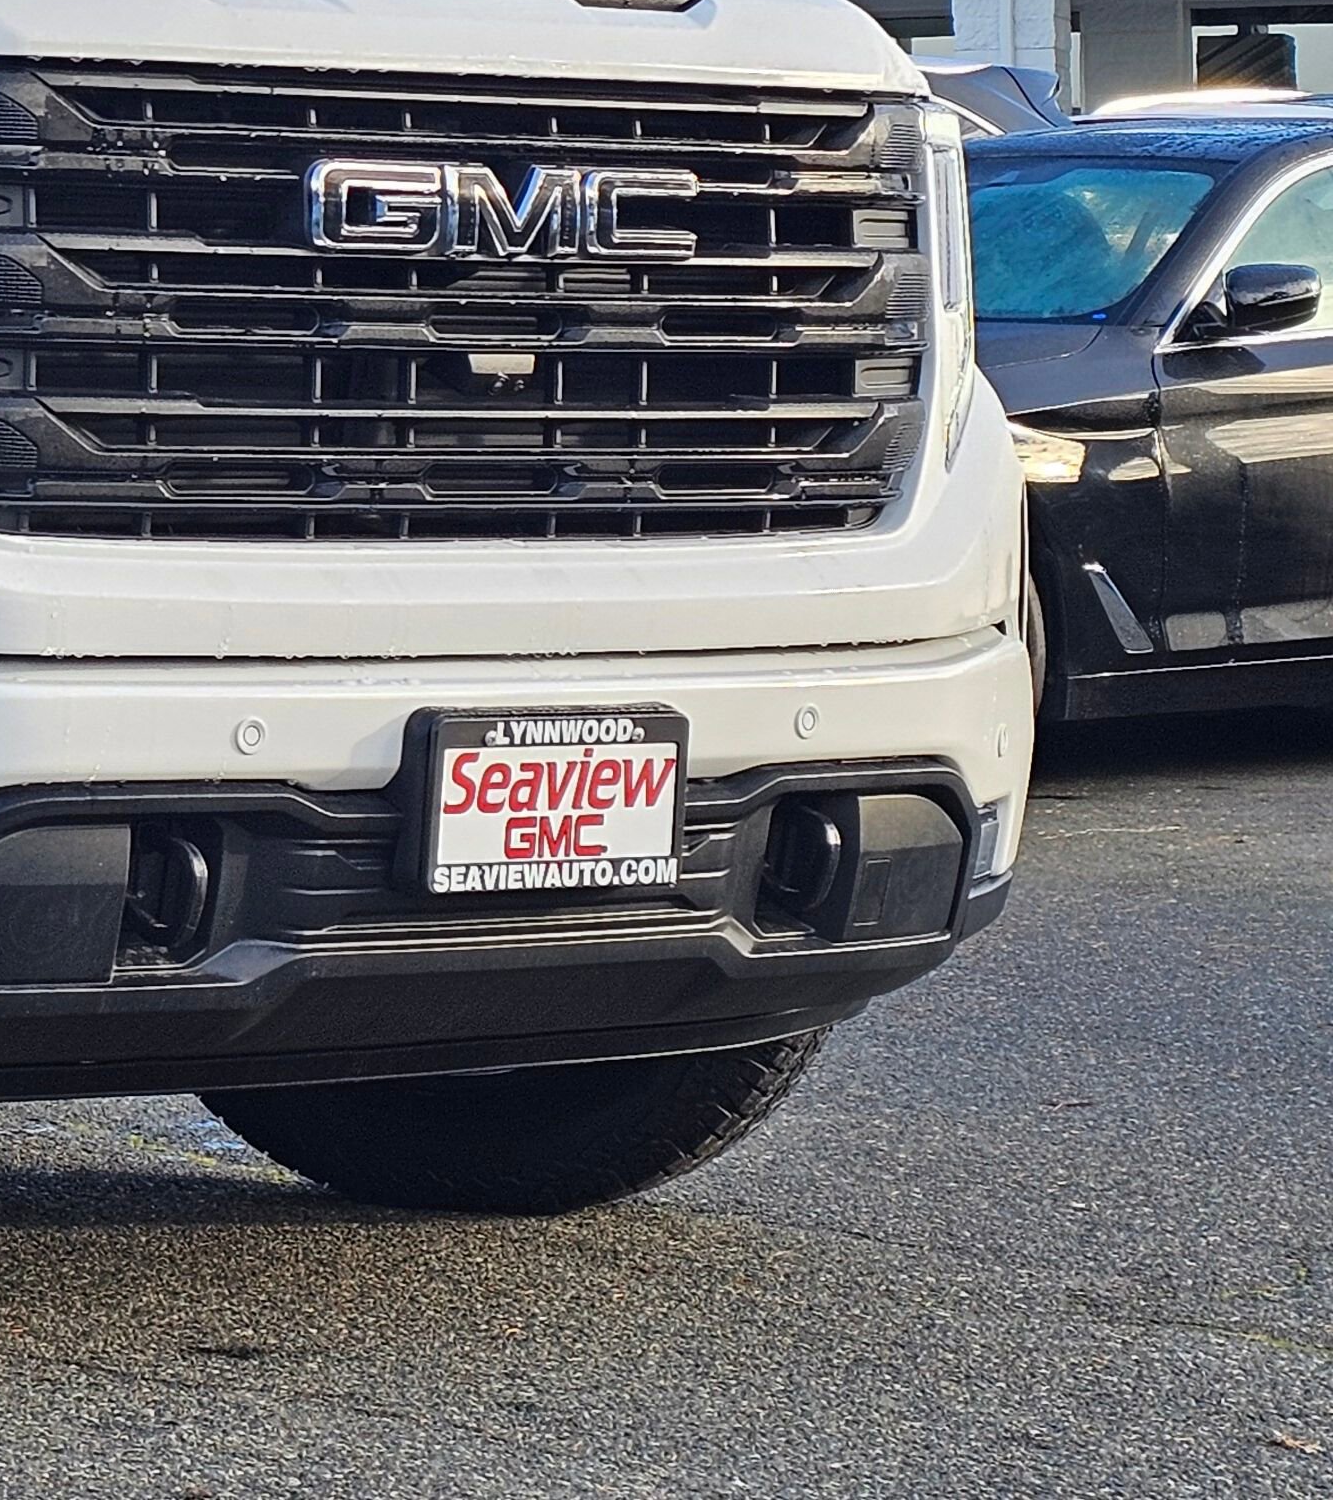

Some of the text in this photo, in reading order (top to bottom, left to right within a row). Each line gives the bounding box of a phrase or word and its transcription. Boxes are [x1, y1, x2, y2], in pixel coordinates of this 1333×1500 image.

[305, 158, 699, 260] GMC
[495, 718, 634, 745] LYNNWOOD
[442, 747, 677, 814] Seaview
[504, 813, 608, 860] GMC
[433, 857, 679, 893] SEAVIEWAUTO.COM
